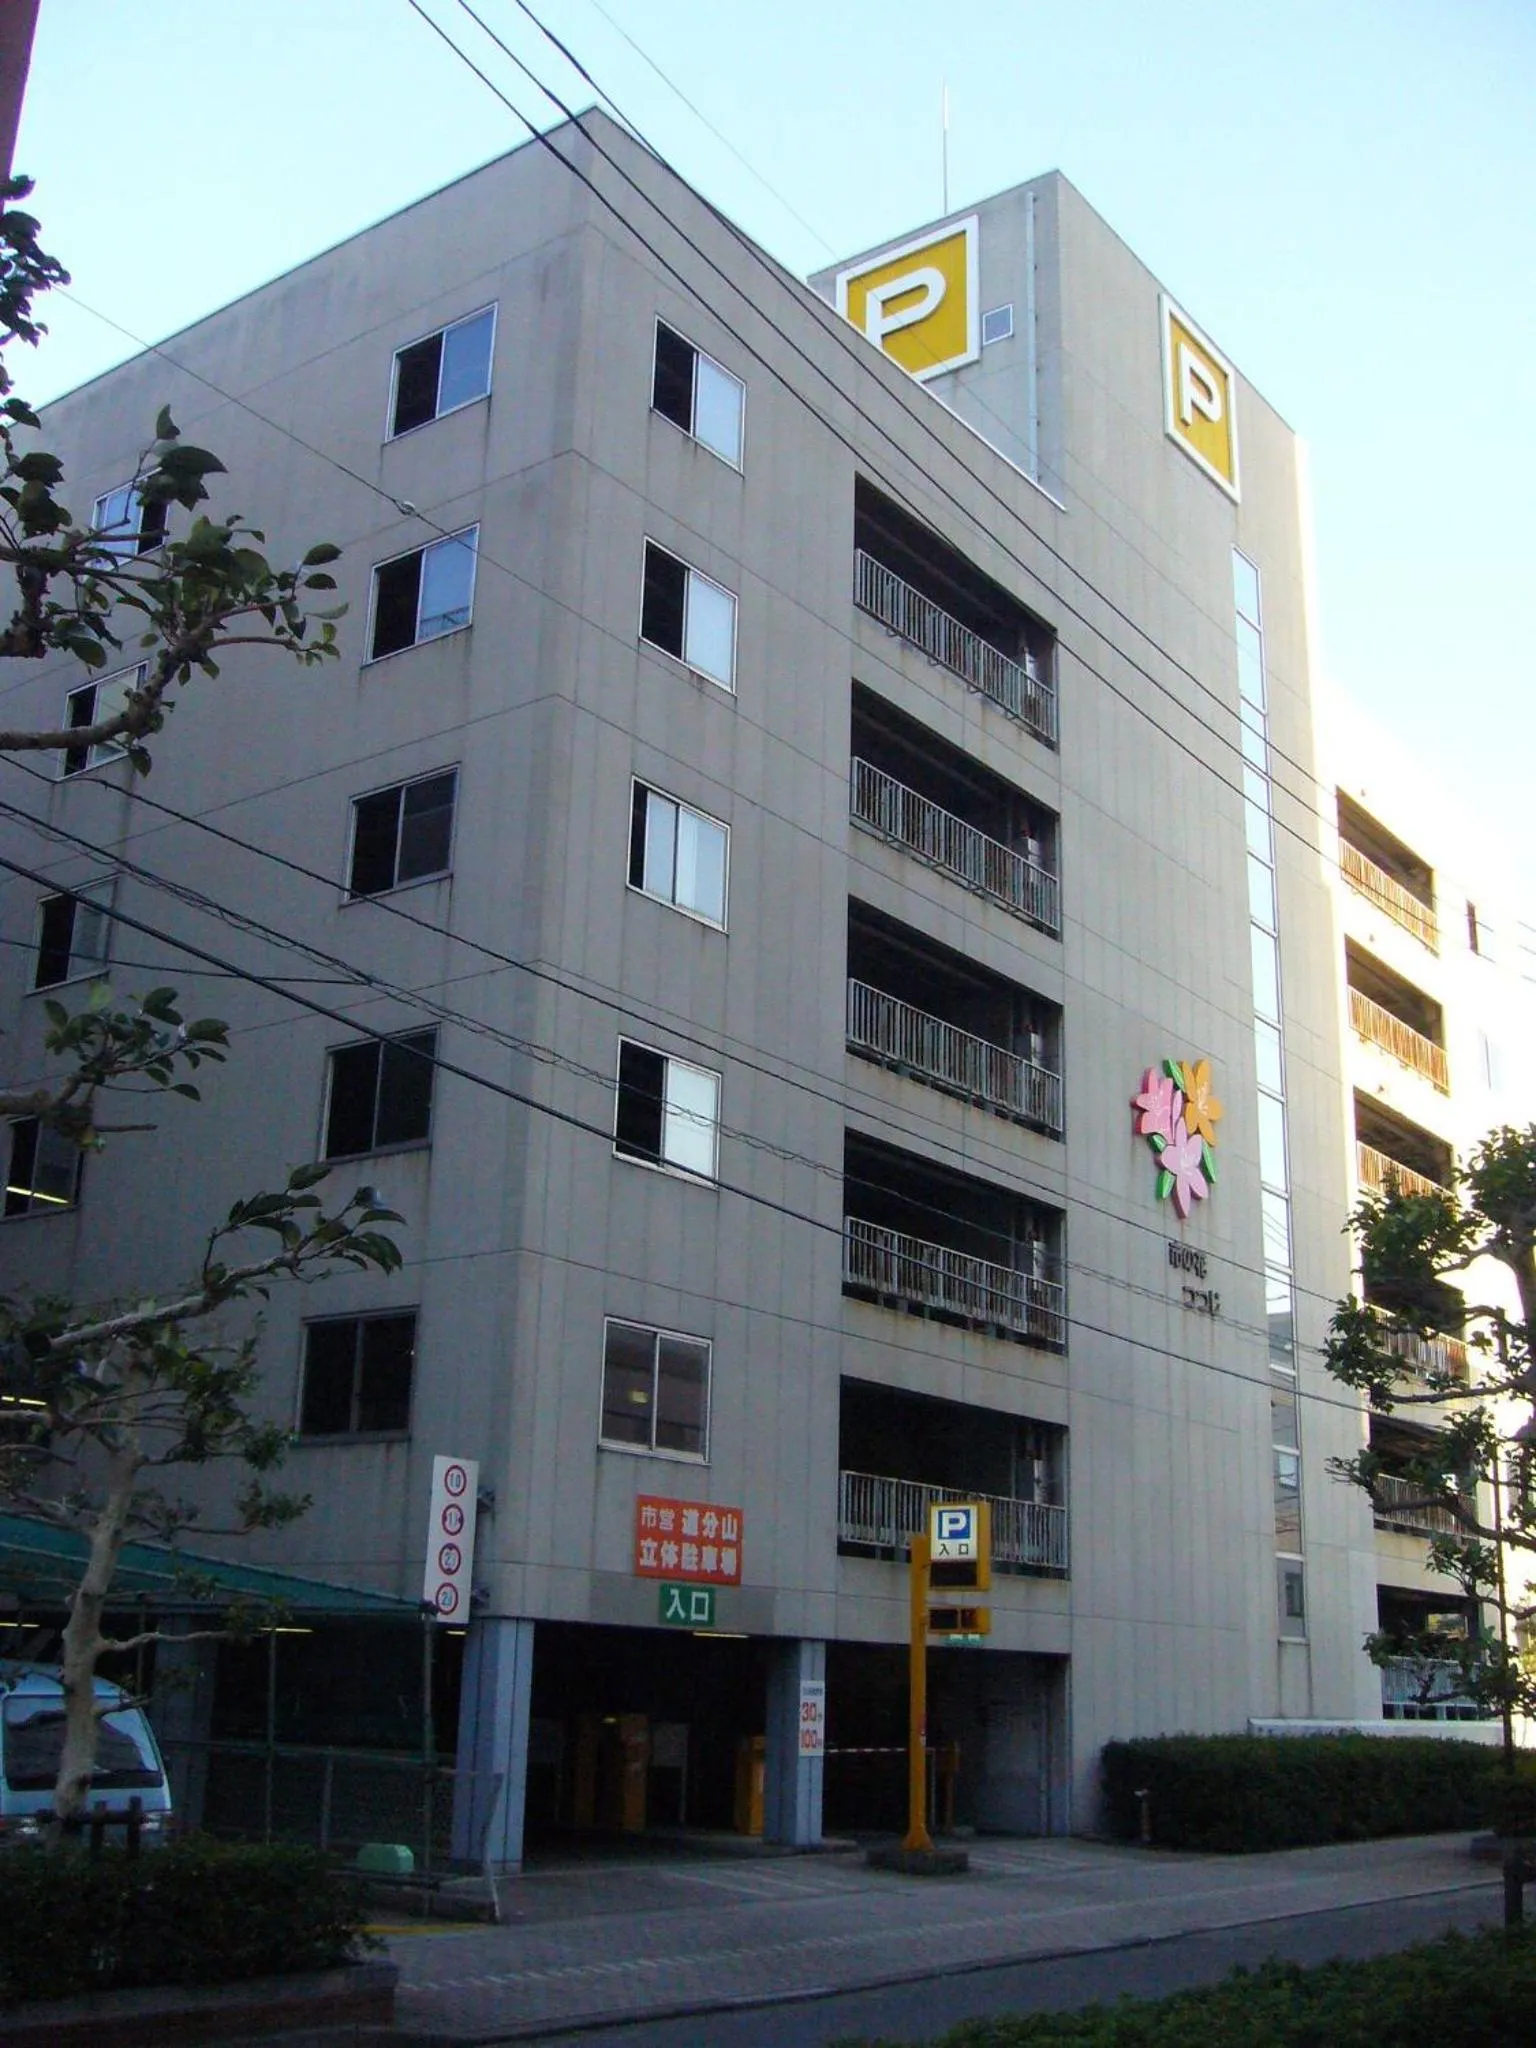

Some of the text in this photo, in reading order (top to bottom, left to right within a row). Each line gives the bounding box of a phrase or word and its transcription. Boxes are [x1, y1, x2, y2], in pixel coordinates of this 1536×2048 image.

[866, 266, 948, 349] P
[1179, 341, 1222, 427] P
[640, 1504, 676, 1531] 市営
[941, 1511, 968, 1538] P
[639, 1537, 737, 1577] 立体駐車場
[938, 1543, 969, 1556] 入口
[665, 1587, 709, 1621] 入口
